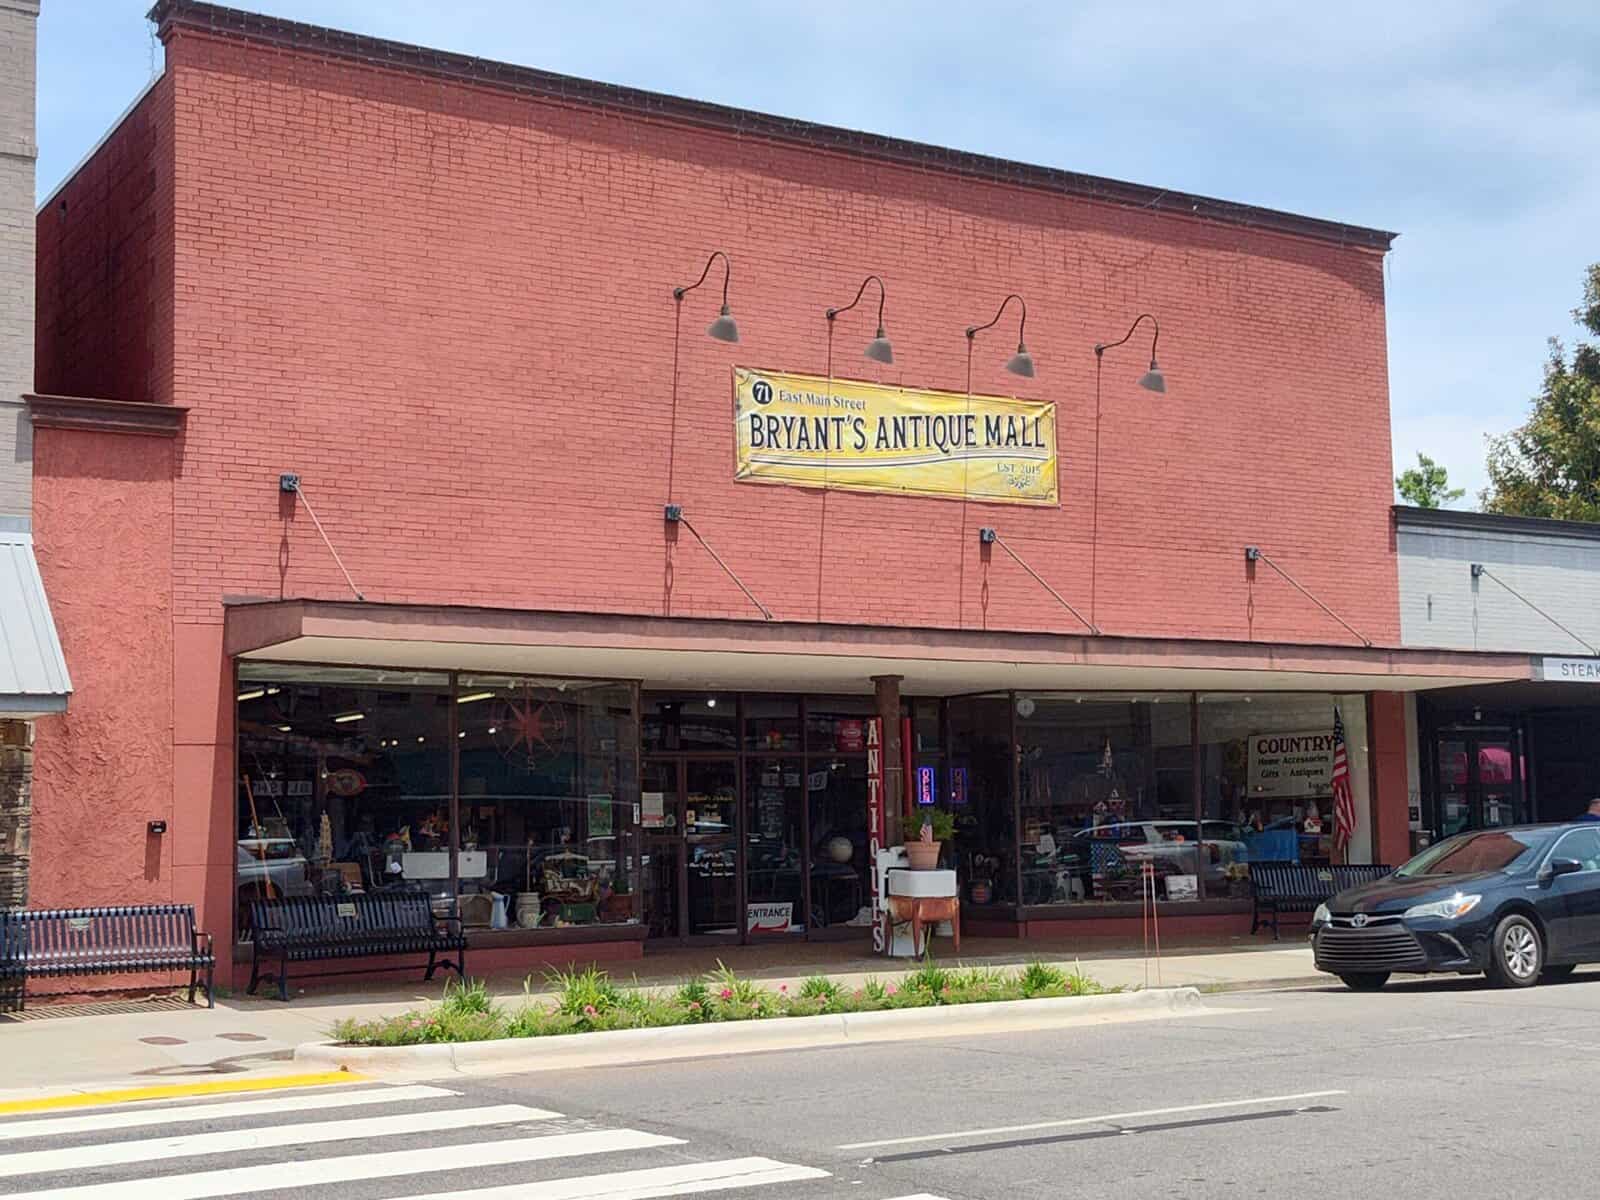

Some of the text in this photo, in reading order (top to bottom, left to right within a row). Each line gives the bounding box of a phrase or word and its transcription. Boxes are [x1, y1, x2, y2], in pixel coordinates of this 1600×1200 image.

[755, 384, 770, 402] 71
[779, 389, 866, 411] East Main Street
[750, 413, 1045, 453] BRYANT'S ANTIQUE MALL
[1257, 736, 1334, 754] COUNTRY
[1290, 768, 1323, 778] Antiques
[922, 768, 931, 802] OPEN
[747, 907, 791, 918] ENTRANCE
